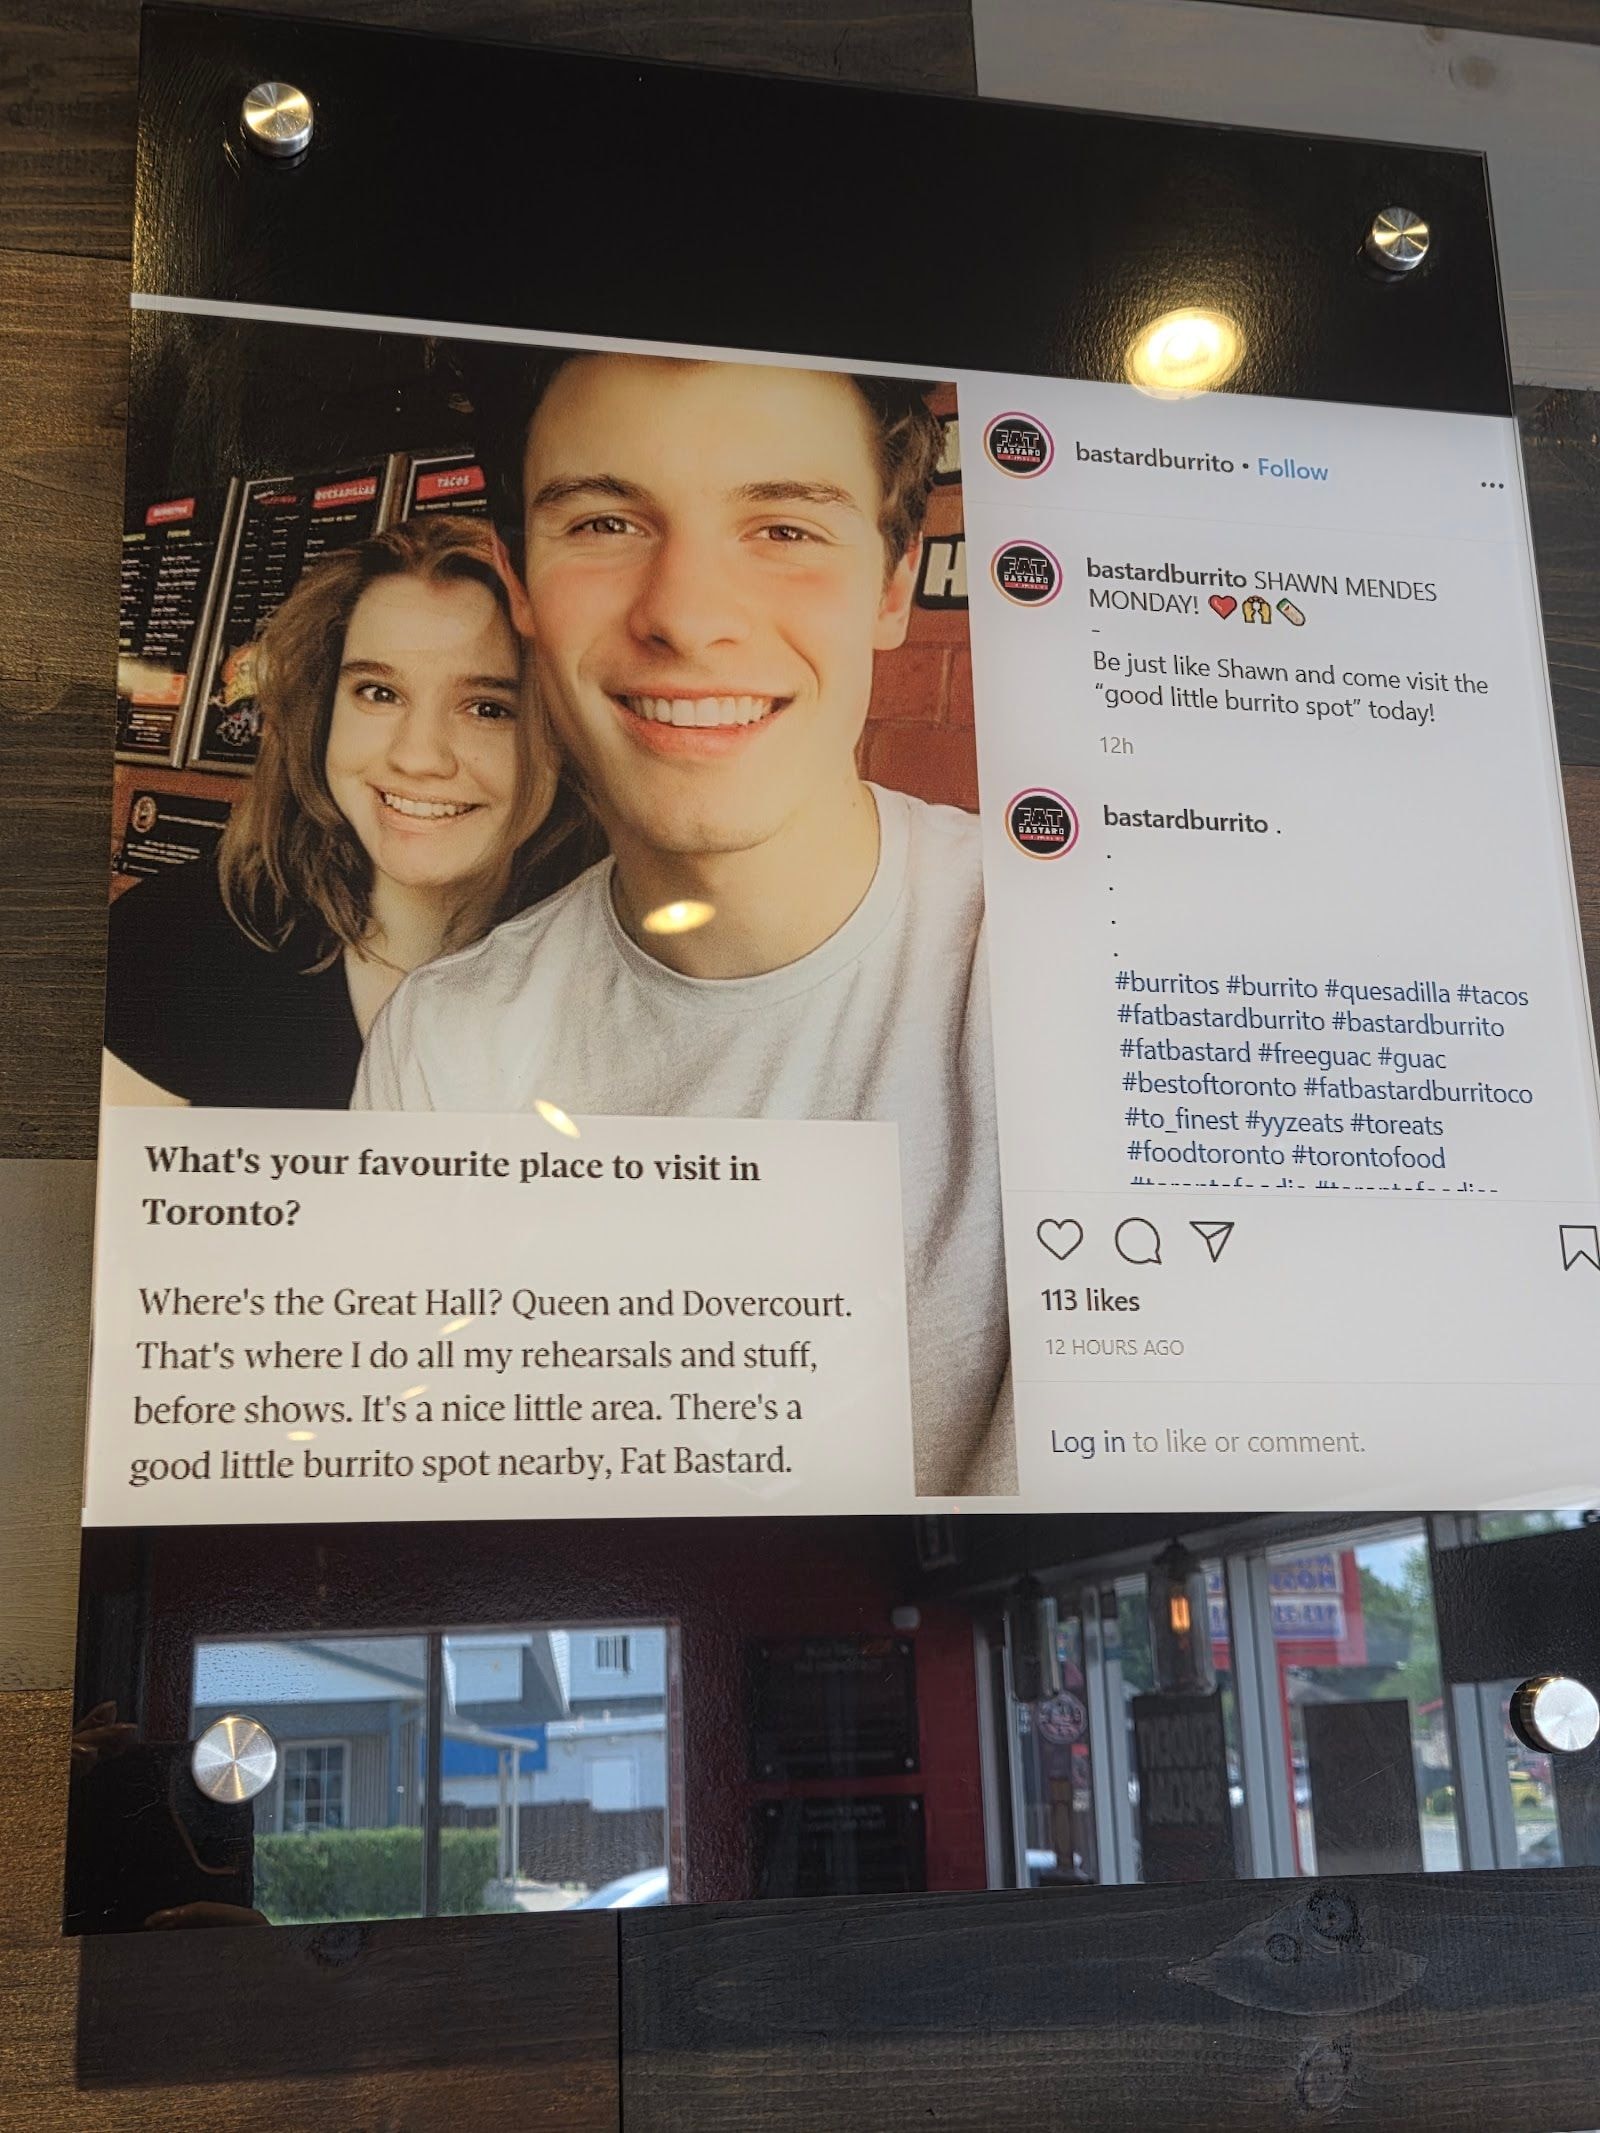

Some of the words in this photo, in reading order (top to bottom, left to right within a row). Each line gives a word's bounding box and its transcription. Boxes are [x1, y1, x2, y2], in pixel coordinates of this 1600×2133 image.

[996, 429, 1040, 449] FAT
[1076, 441, 1234, 473] bastardburrito
[1259, 458, 1328, 480] Follow
[437, 475, 470, 488] TACOS
[1003, 556, 1047, 576] FAT
[1087, 557, 1247, 588] bastardburrito
[1254, 571, 1338, 595] SHAWN
[1346, 577, 1437, 601] MENDES
[1089, 589, 1199, 614] MONDAY!
[1093, 651, 1120, 671] Be
[1125, 653, 1167, 677] just
[1174, 655, 1210, 676] like
[1217, 658, 1288, 681] Shawn
[1295, 665, 1335, 684] and
[1342, 672, 1400, 688] come
[1406, 672, 1450, 691] visit
[1454, 673, 1488, 694] the
[1171, 686, 1218, 709] little
[1225, 689, 1299, 713] burrito
[1368, 700, 1435, 727] today!
[1100, 737, 1133, 754] 12h
[1018, 807, 1063, 827] FAT
[1104, 805, 1268, 833] bastardburrito
[1115, 970, 1219, 994] #burritos
[1226, 974, 1318, 998] #burrito
[1324, 979, 1450, 1005] #quesadilla
[1457, 984, 1528, 1006] #tacos
[1117, 1003, 1325, 1030] #fatbastardburrito
[1331, 1010, 1504, 1037] #bastardburrito
[1120, 1037, 1251, 1062] #fatbastard
[1258, 1042, 1371, 1071] #freeguac
[1378, 1047, 1446, 1073] #guac
[1122, 1071, 1297, 1097] #bestoftoronto
[1303, 1076, 1533, 1103] #fatbastardburritoco
[1124, 1107, 1240, 1133] #to_finest
[1245, 1110, 1344, 1137] #yyzeats
[1350, 1113, 1443, 1135] #toreats
[144, 1146, 261, 1174] What's
[270, 1154, 349, 1180] your
[358, 1148, 510, 1177] favourite
[520, 1152, 604, 1183] place
[612, 1155, 644, 1180] to
[653, 1154, 721, 1181] visit
[729, 1155, 762, 1181] in
[1127, 1139, 1285, 1165] #foodtoronto
[1292, 1145, 1445, 1168] #torontofood
[142, 1199, 301, 1226] Toronto?
[138, 1287, 265, 1315] Where's
[274, 1287, 324, 1315] the
[334, 1288, 418, 1315] Great
[425, 1288, 502, 1316] Hall?
[512, 1289, 610, 1320] Queen
[619, 1289, 674, 1316] and
[683, 1290, 852, 1317] Dovercourt.
[1041, 1289, 1078, 1311] 113
[1086, 1288, 1140, 1311] likes
[136, 1341, 235, 1370] That's
[244, 1341, 343, 1369] where
[351, 1341, 360, 1368] I
[369, 1341, 408, 1369] do
[417, 1341, 454, 1369] all
[464, 1348, 513, 1374] my
[521, 1341, 672, 1369] rehearsals
[681, 1341, 736, 1368] and
[744, 1341, 817, 1373] stuff,
[1046, 1339, 1066, 1354] 12
[1073, 1339, 1137, 1355] HOURS
[1144, 1340, 1184, 1355] AGO
[133, 1394, 236, 1425] before
[244, 1395, 353, 1424] shows.
[361, 1395, 407, 1423] It's
[416, 1402, 433, 1422] a
[441, 1394, 506, 1422] nice
[513, 1394, 583, 1422] little
[591, 1400, 662, 1421] area.
[670, 1393, 778, 1421] There's
[787, 1400, 803, 1419] a
[1052, 1430, 1095, 1459] Log
[1104, 1430, 1125, 1452] in
[1132, 1432, 1158, 1452] to
[1166, 1428, 1206, 1452] like
[1216, 1437, 1240, 1452] or
[1248, 1432, 1365, 1452] comment.
[128, 1450, 211, 1487] good
[220, 1449, 294, 1479] little
[304, 1448, 414, 1478] burrito
[422, 1450, 491, 1483] spot
[498, 1446, 612, 1481] nearby,
[620, 1447, 666, 1474] Fat
[673, 1445, 792, 1473] Bastard.
